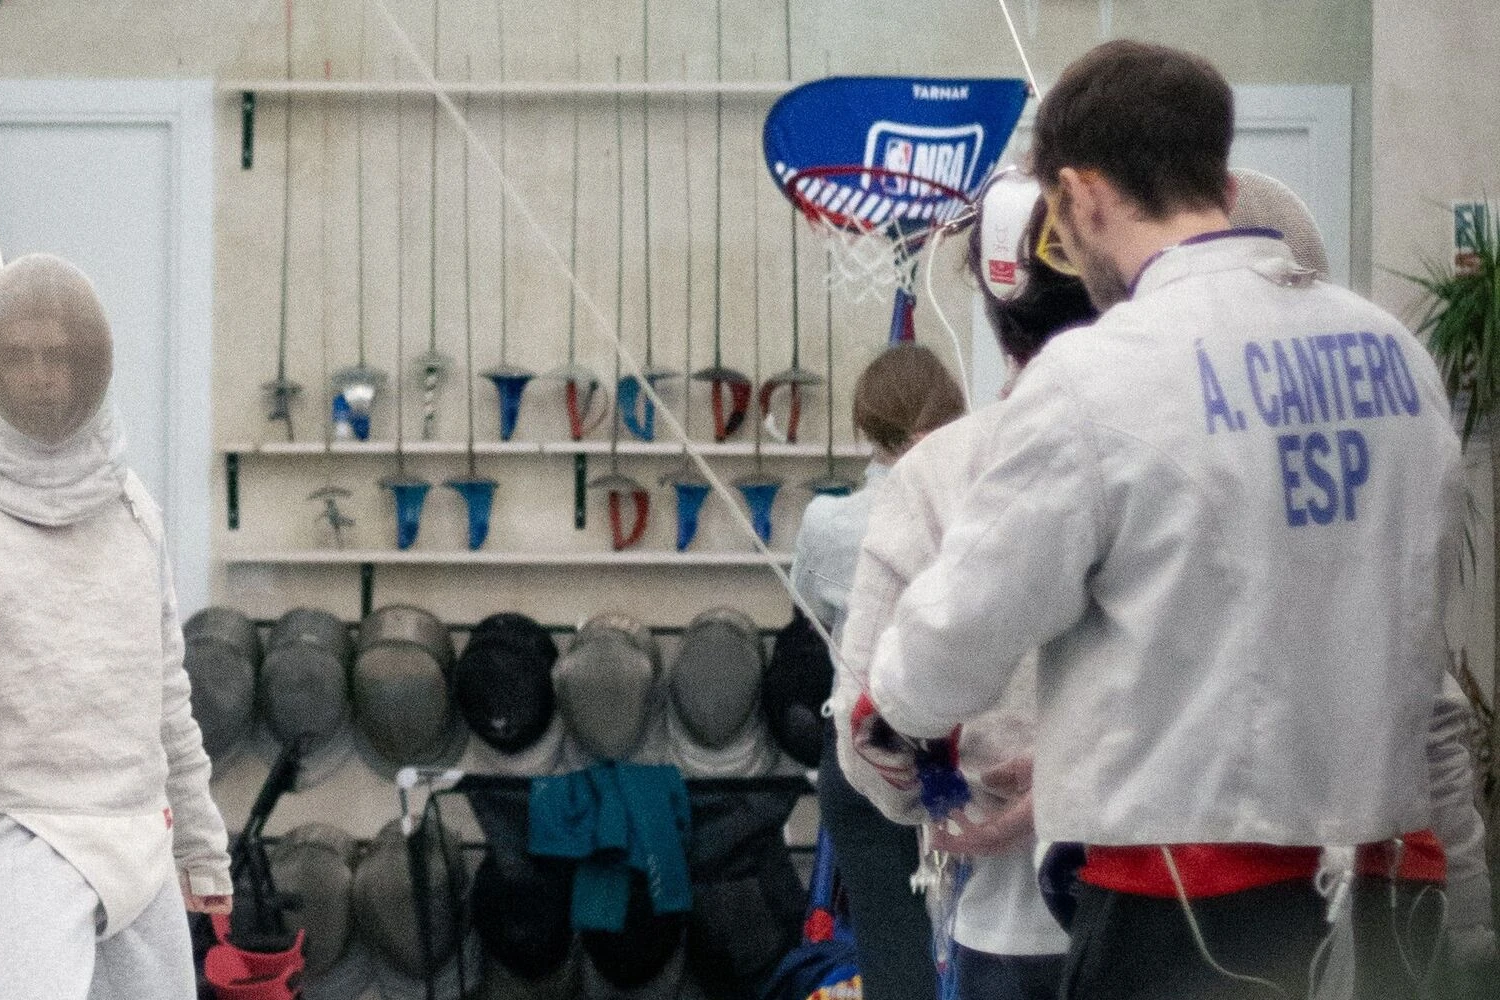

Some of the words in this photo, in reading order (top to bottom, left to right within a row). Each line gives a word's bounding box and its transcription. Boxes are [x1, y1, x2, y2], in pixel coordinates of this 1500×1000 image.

[912, 84, 969, 100] TARMAK
[1194, 338, 1248, 434] A.
[1244, 332, 1420, 427] CANTERO
[1277, 429, 1370, 527] ESP
